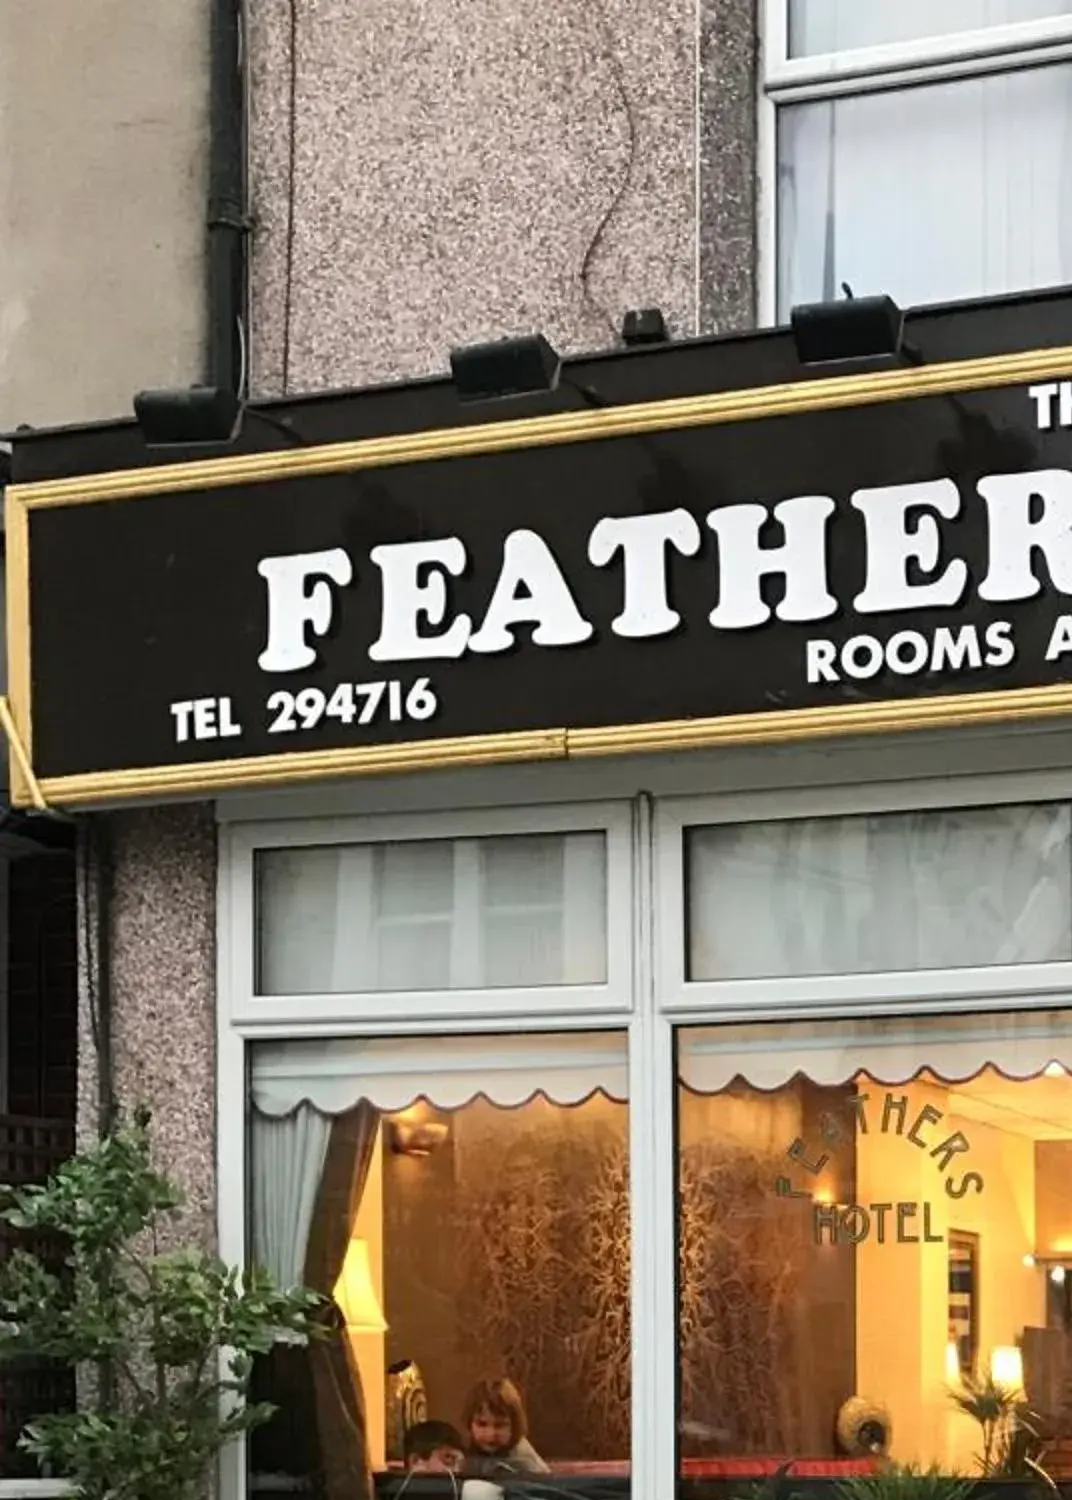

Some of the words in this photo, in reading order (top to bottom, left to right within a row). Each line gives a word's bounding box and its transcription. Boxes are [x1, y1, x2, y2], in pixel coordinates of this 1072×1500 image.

[806, 621, 1015, 683] ROOMS
[170, 697, 241, 742] TEL
[266, 679, 437, 735] 294716
[775, 1093, 985, 1200] FEATHERS
[812, 1201, 944, 1244] HOTEL
